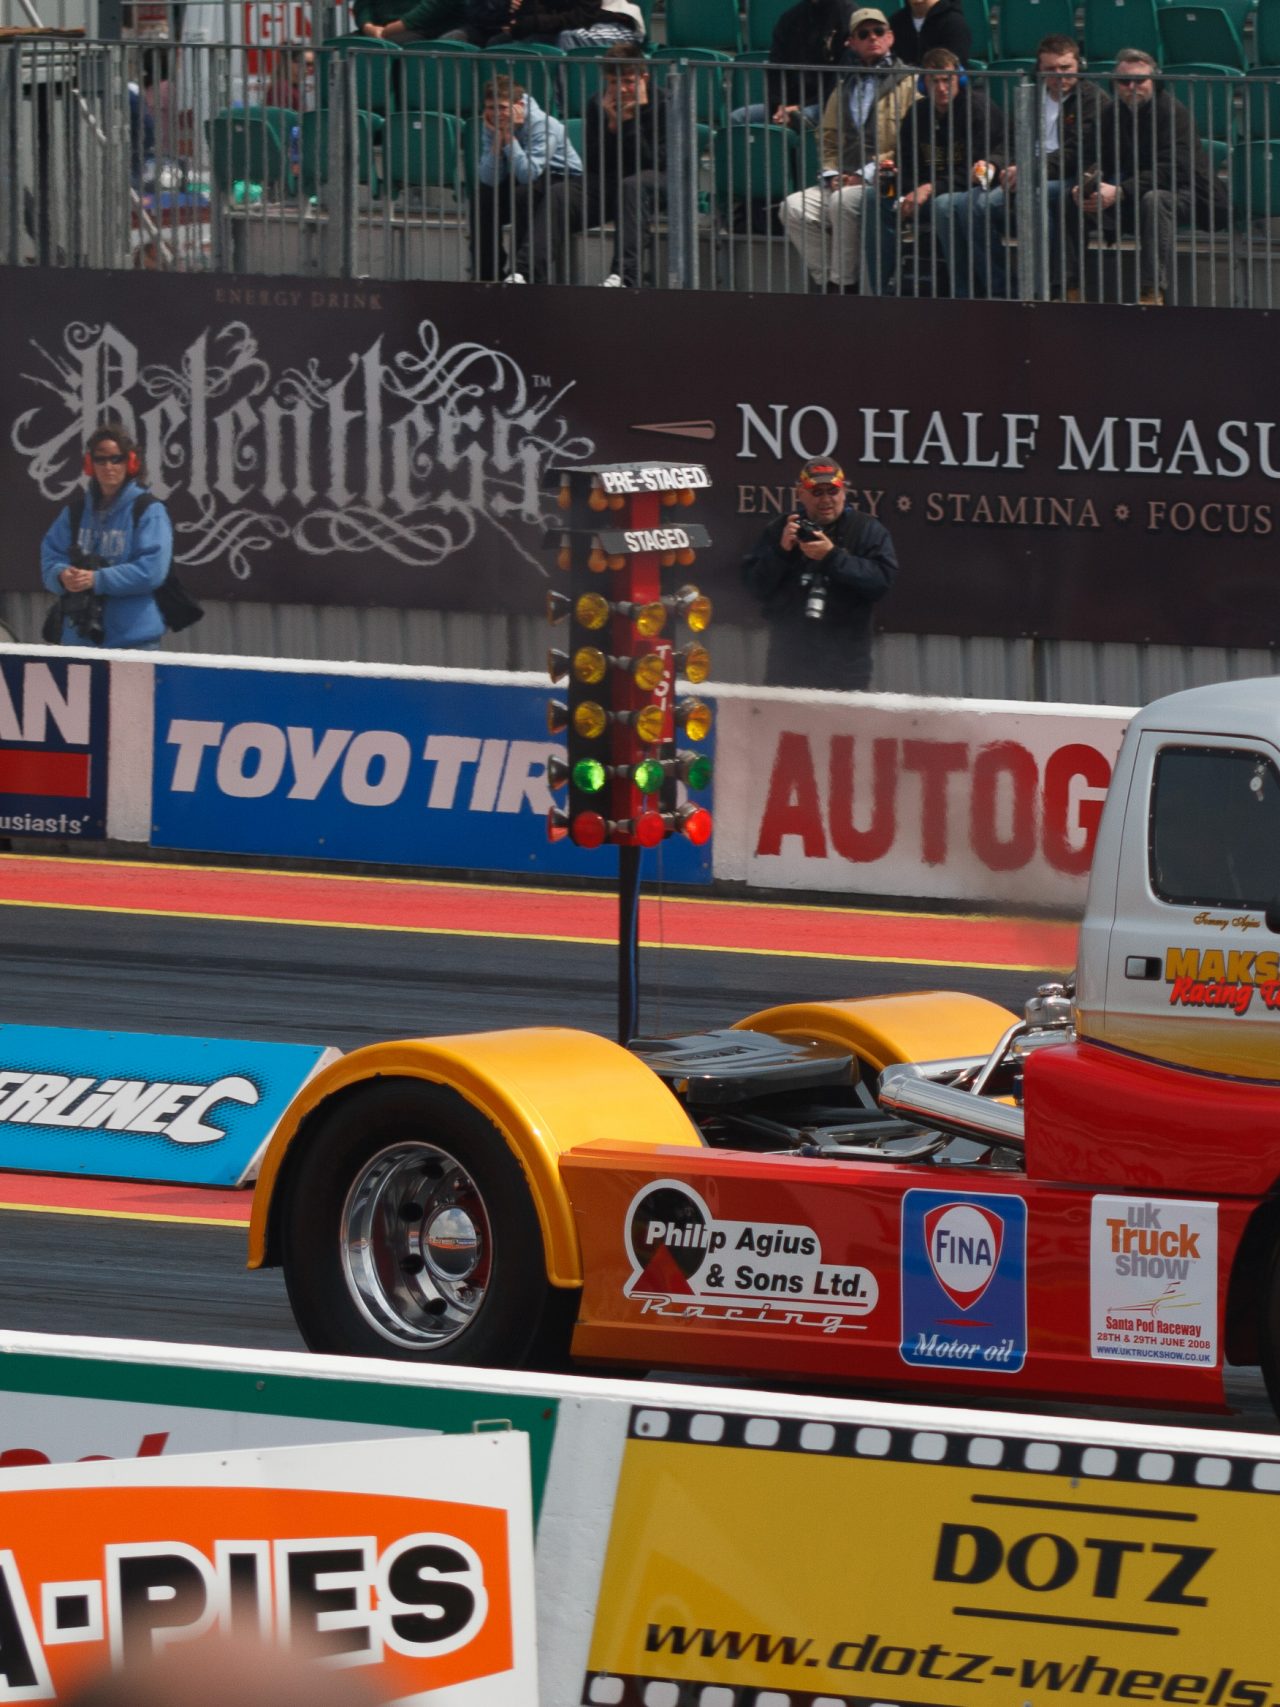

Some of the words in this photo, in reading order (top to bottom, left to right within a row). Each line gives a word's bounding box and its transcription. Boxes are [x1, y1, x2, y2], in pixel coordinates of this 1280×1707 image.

[736, 403, 838, 461] NO
[859, 408, 1040, 469] HALF
[602, 466, 707, 493] PRE-STAGED
[926, 492, 1101, 527] STAMINA
[1148, 501, 1273, 534] FOCUS
[624, 528, 690, 553] STAGED
[167, 719, 411, 807] TOYO
[1168, 976, 1254, 1017] Racing
[1128, 1202, 1161, 1229] uk
[646, 1221, 727, 1253] Philip
[735, 1228, 816, 1257] Agius
[936, 1230, 992, 1266] FINA
[1106, 1218, 1201, 1259] Truck
[706, 1264, 725, 1288] &
[735, 1266, 804, 1294] Sons
[813, 1271, 867, 1298] Ltd.
[1115, 1250, 1190, 1280] show
[629, 1292, 868, 1333] Racing
[1106, 1316, 1134, 1331] Santa
[1136, 1318, 1155, 1333] Pod
[1157, 1320, 1201, 1337] Raceway
[913, 1333, 981, 1360] Motor
[984, 1339, 1014, 1362] oil
[1096, 1345, 1211, 1362] WWW.UKTRUCKSHOW.CO.UK
[1097, 1332, 1121, 1342] 28TH
[1123, 1334, 1131, 1343] &
[1133, 1335, 1157, 1345] 29TH
[1160, 1338, 1185, 1347] JUNE
[1188, 1339, 1211, 1349] 2008
[933, 1522, 1217, 1607] DOTZ
